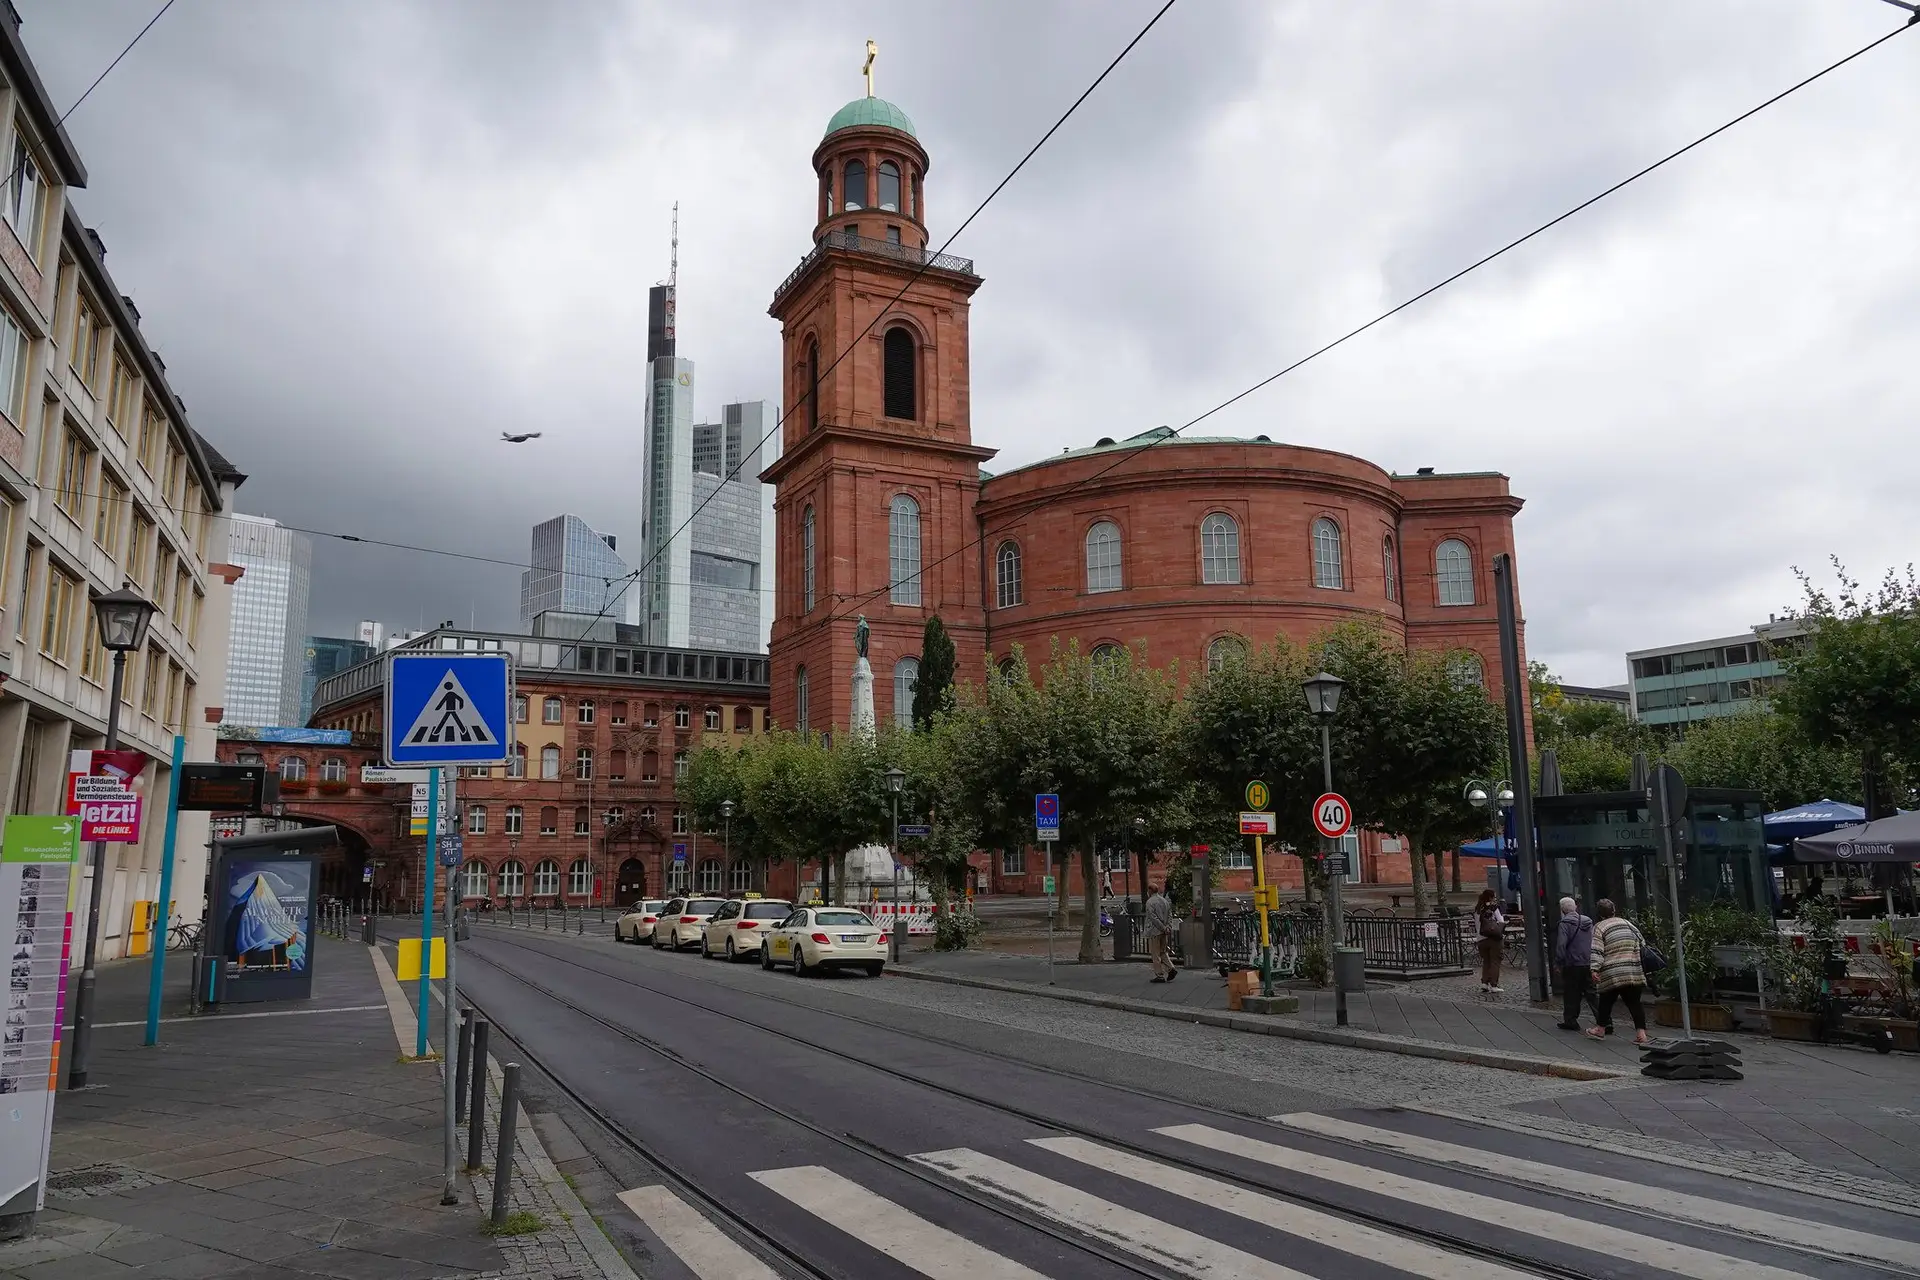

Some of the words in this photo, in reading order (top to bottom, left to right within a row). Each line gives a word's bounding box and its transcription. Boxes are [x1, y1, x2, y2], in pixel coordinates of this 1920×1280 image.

[77, 777, 89, 785] Für
[90, 777, 117, 786] Bildung
[91, 785, 124, 793] Soziales:
[76, 792, 135, 801] Vermögensteuer.
[1252, 787, 1263, 805] H
[73, 804, 136, 823] Jetzt!
[412, 805, 428, 813] N12
[1322, 806, 1344, 825] 40
[1039, 817, 1057, 825] TAXI
[92, 826, 106, 834] DIE
[441, 840, 452, 849] SH
[1854, 844, 1895, 855] BINDING
